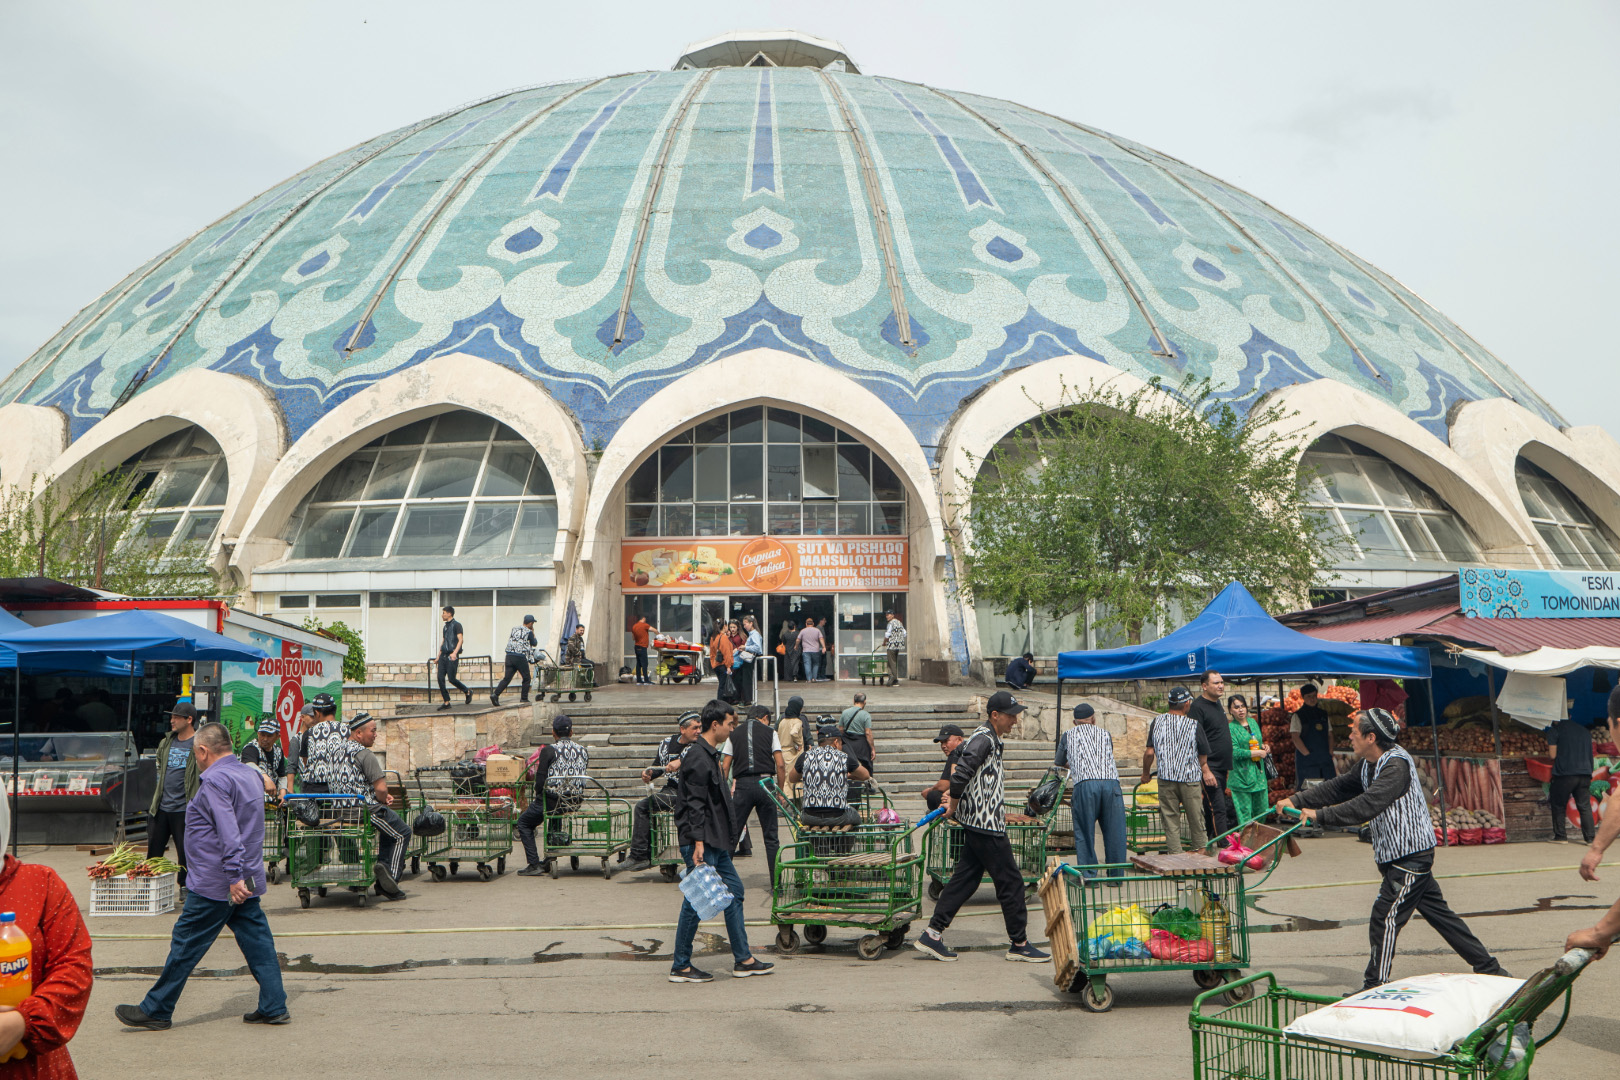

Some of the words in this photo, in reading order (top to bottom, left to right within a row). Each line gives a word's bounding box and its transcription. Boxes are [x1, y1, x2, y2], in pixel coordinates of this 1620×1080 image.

[797, 543, 823, 554] SUT
[826, 543, 844, 554] VA
[847, 542, 904, 555] PISHLOQ
[742, 548, 782, 566] Сырная
[800, 554, 902, 566] MAHSULOTLARI
[747, 561, 786, 582] Лавка
[860, 567, 903, 577] Gumbaz
[801, 576, 836, 586] ichida
[838, 576, 898, 587] joylashgan
[1540, 595, 1620, 611] TOMONIDAN
[257, 657, 283, 676] ZOR
